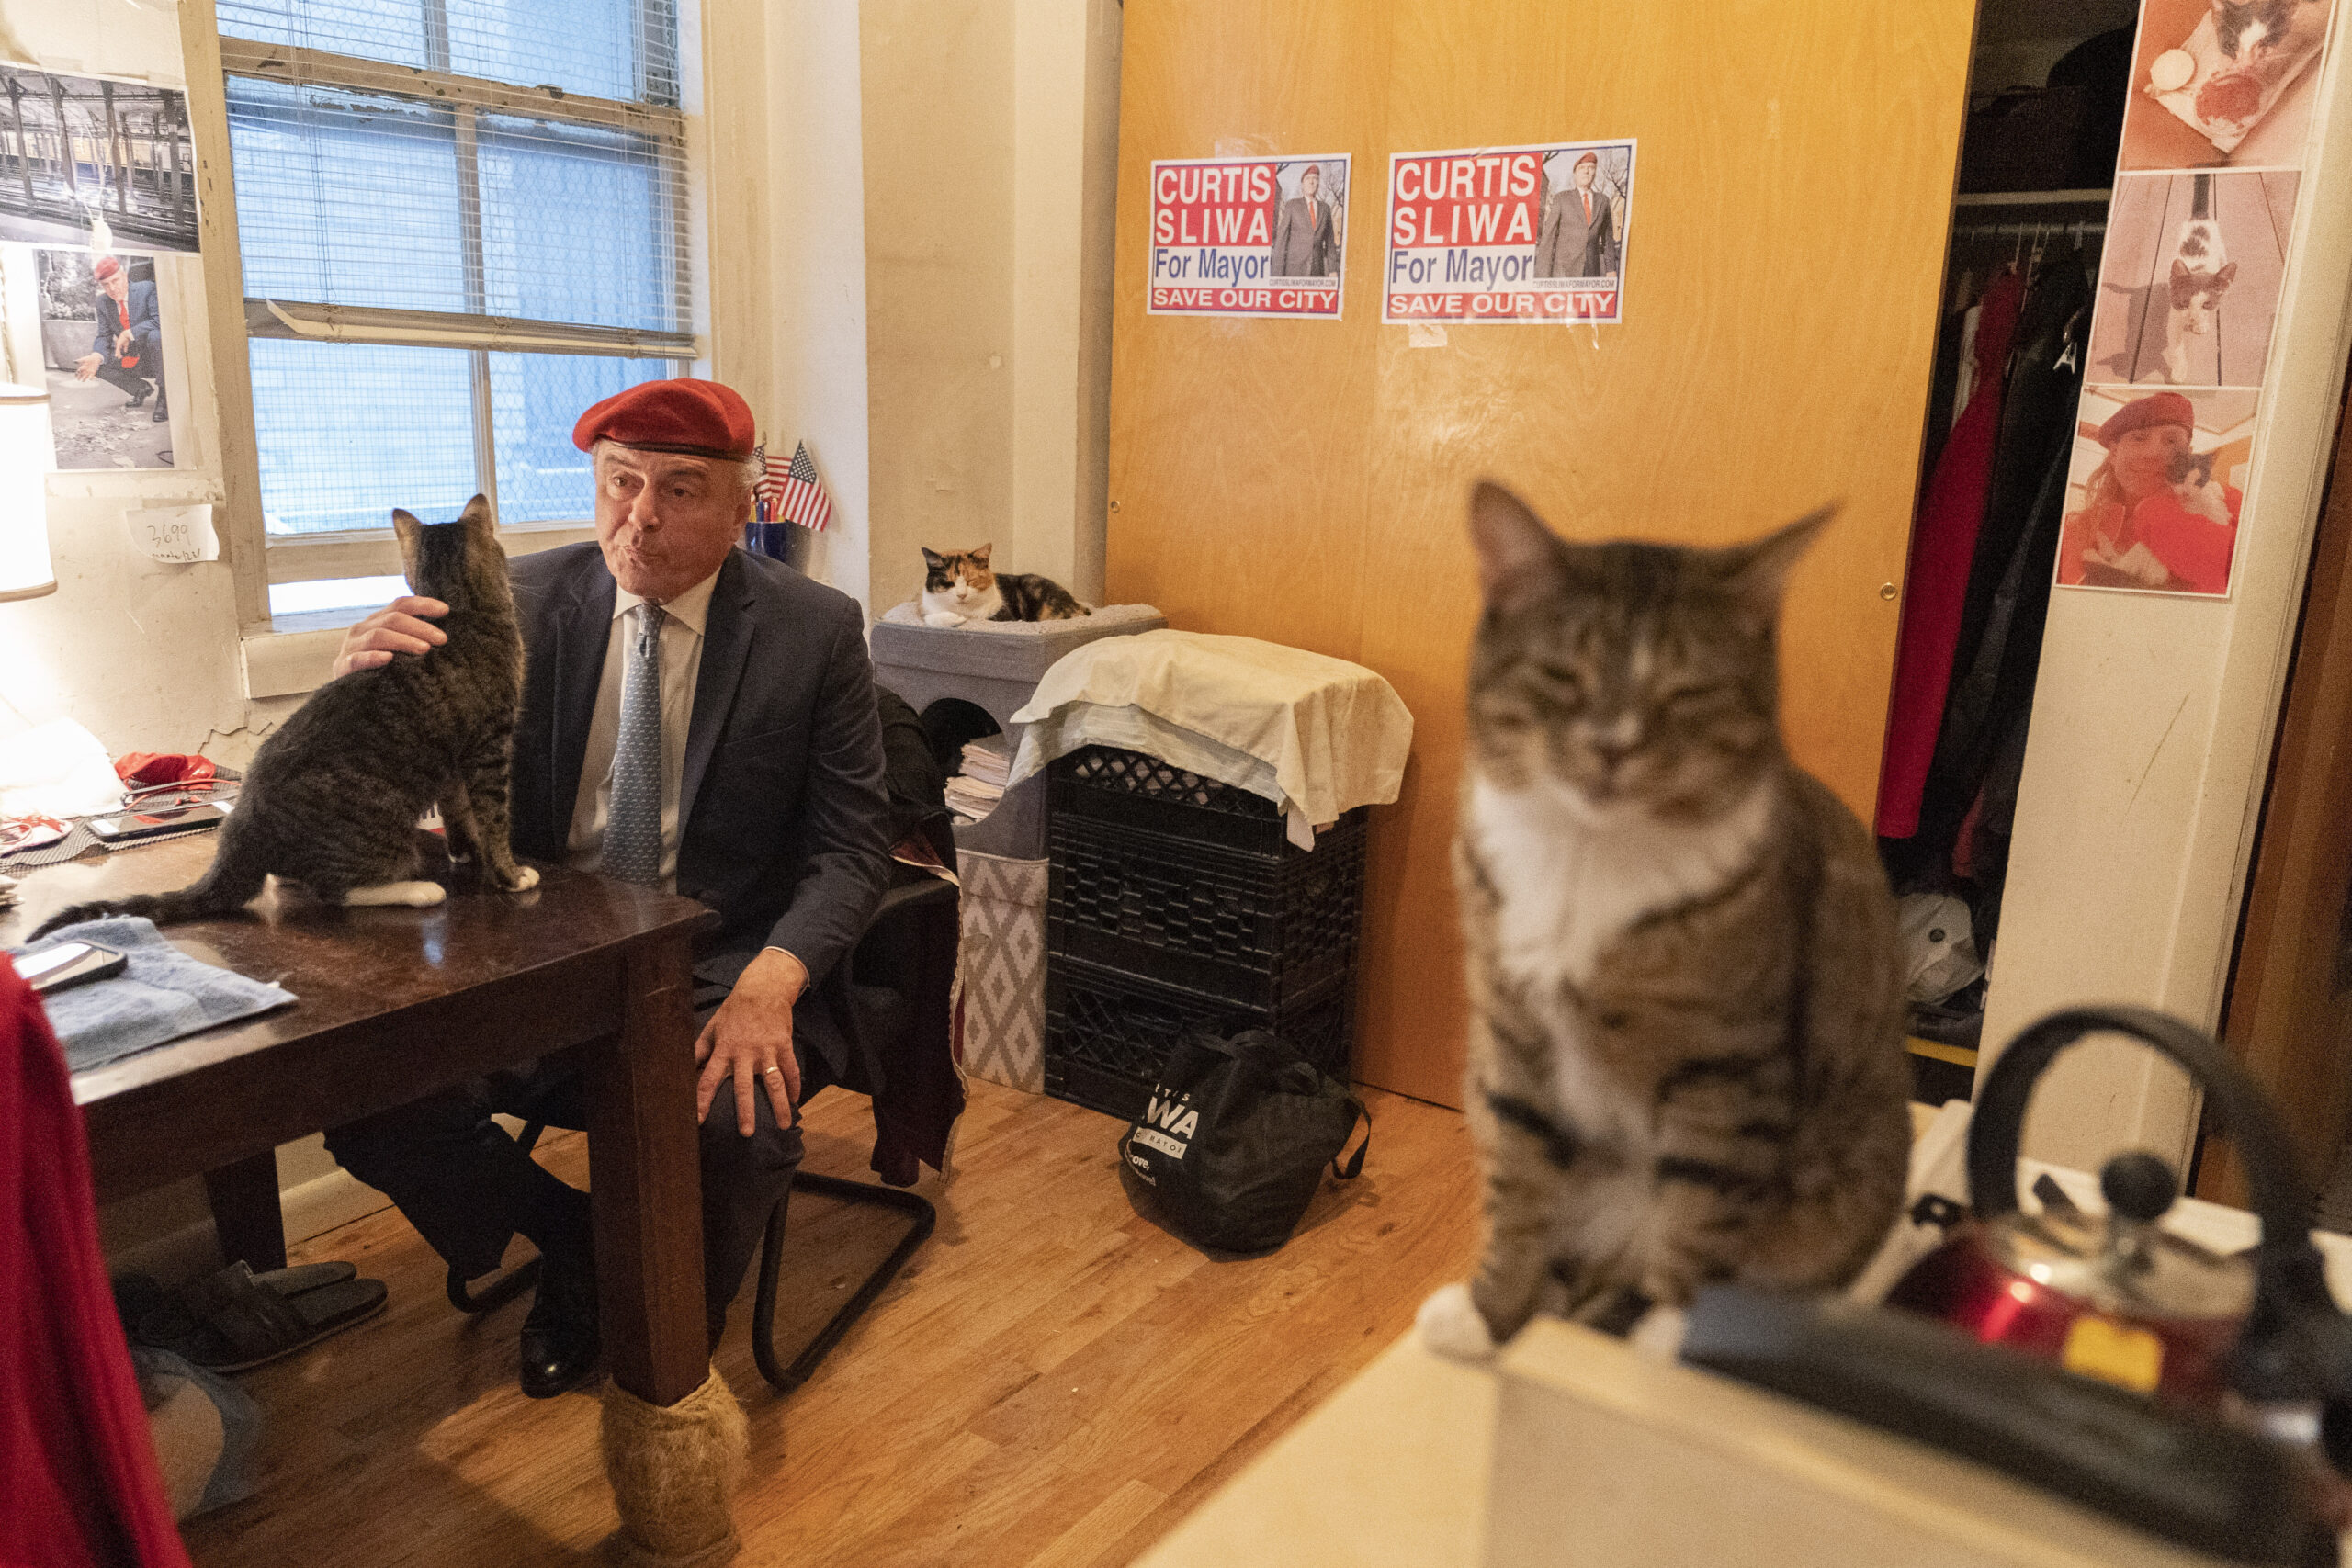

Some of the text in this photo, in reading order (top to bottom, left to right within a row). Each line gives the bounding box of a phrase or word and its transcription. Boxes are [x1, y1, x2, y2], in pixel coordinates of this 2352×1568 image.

[1157, 165, 1271, 205] CURTIS
[1396, 155, 1536, 202] CURTIS
[1156, 208, 1269, 244] SLIWA
[1393, 202, 1532, 245] SLIWA
[1155, 248, 1269, 288] For Mayor
[1392, 248, 1533, 291] For Mayor
[1154, 289, 1336, 309] SAVE OUR CITY
[1390, 293, 1614, 313] SAVE OUR CITY
